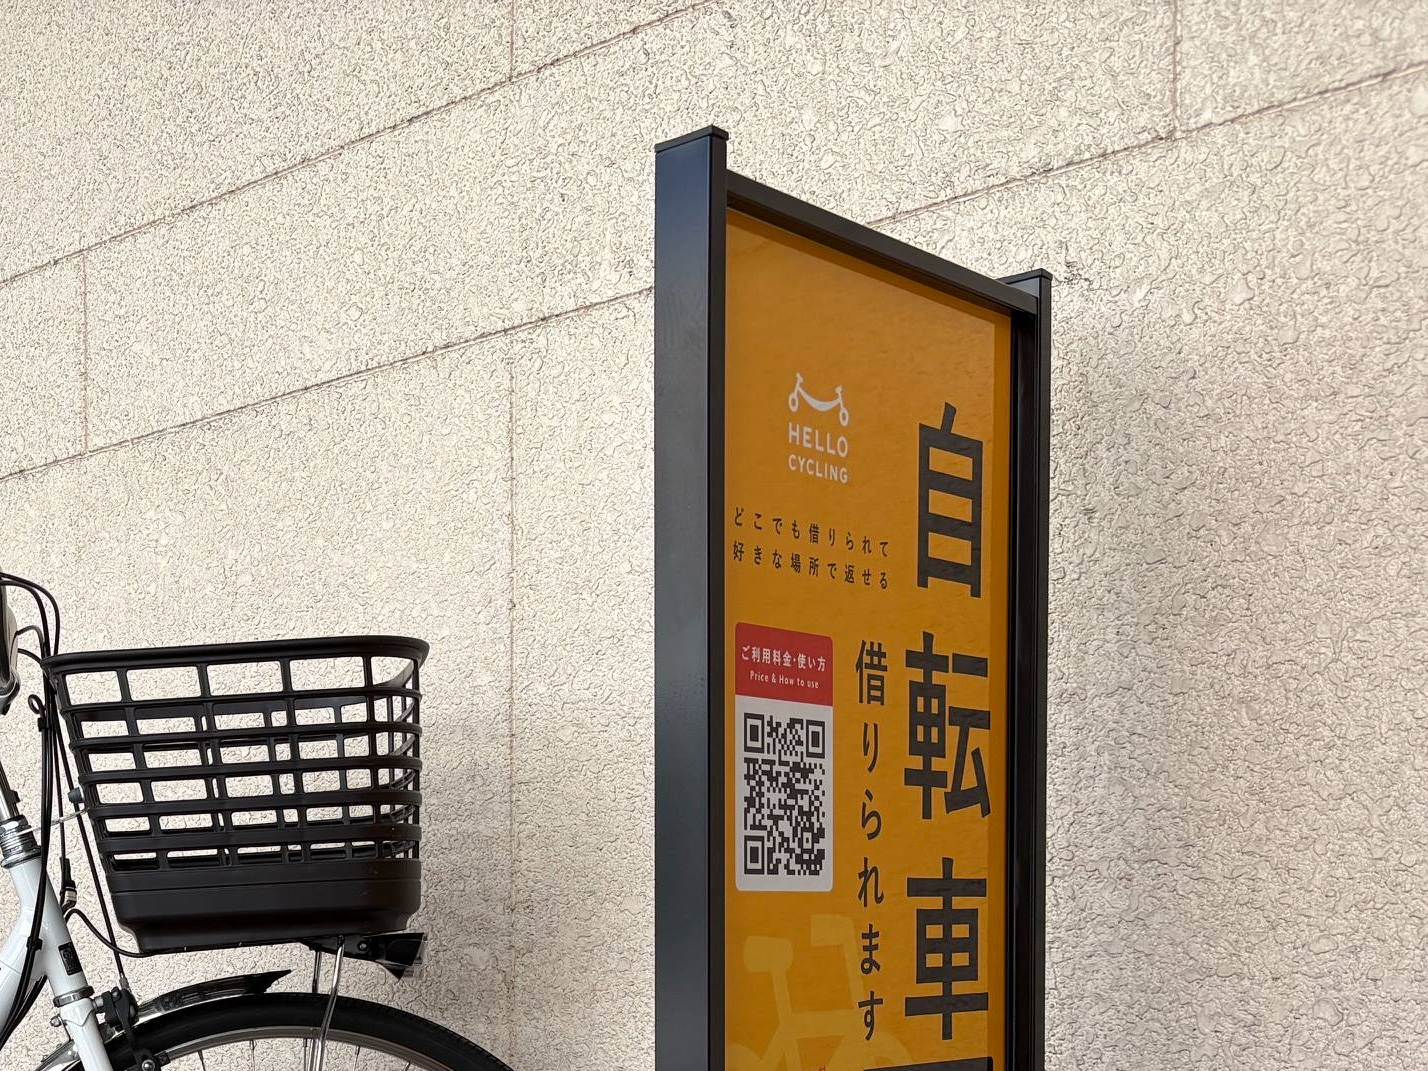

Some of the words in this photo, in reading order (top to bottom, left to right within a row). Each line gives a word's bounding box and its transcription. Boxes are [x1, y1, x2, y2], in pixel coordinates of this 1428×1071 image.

[788, 422, 849, 458] HELLO
[788, 455, 849, 484] CYCLING
[733, 507, 890, 559] どこでも借りられて
[732, 540, 889, 591] 好きな場所で返せる
[750, 671, 770, 685] Price
[771, 673, 778, 684] &
[778, 674, 795, 687] How
[797, 677, 805, 688] to
[807, 679, 820, 690] use
[904, 401, 991, 1041] 自転車
[855, 639, 888, 1041] 借りられます
